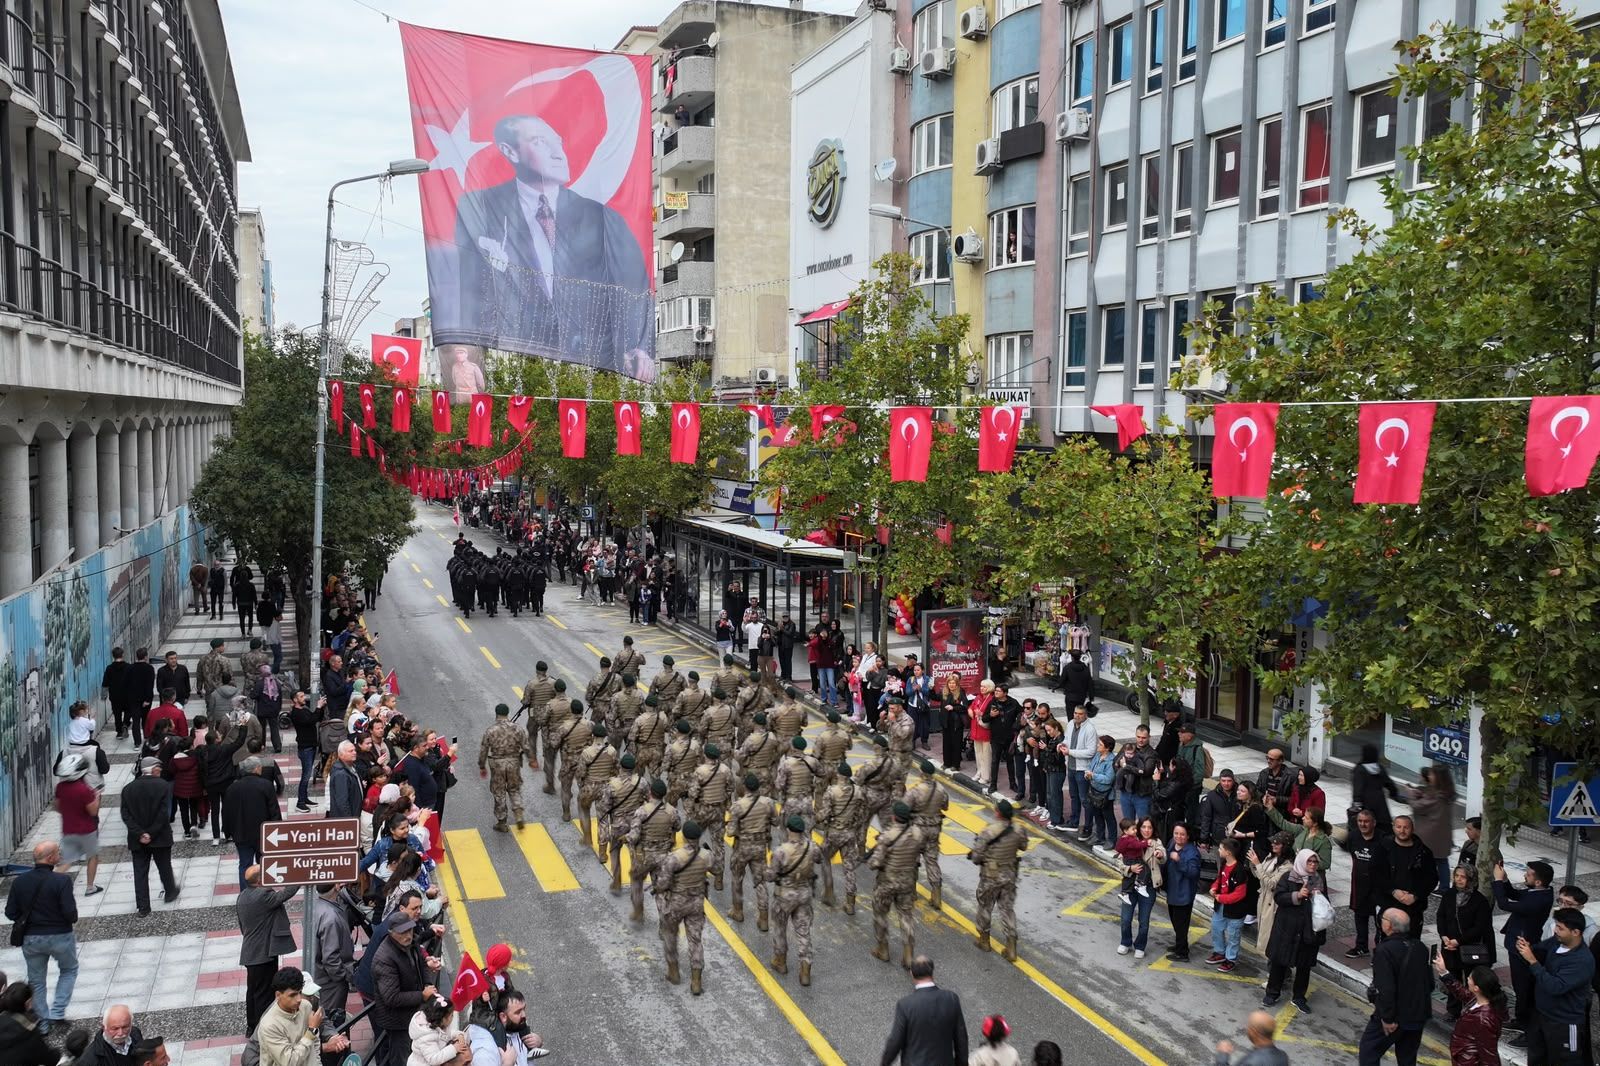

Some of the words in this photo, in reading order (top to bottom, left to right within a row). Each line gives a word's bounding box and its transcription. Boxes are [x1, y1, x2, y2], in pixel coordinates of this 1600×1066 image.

[990, 391, 1029, 402] AVUKAT
[932, 660, 978, 671] Cumhuriyet
[932, 669, 979, 678] Bayrımız
[1429, 733, 1463, 756] 849
[1461, 751, 1468, 759] TL
[290, 829, 321, 843] Yeni
[325, 828, 354, 841] Han
[293, 856, 352, 869] Kurşunlu
[309, 870, 334, 880] Han
